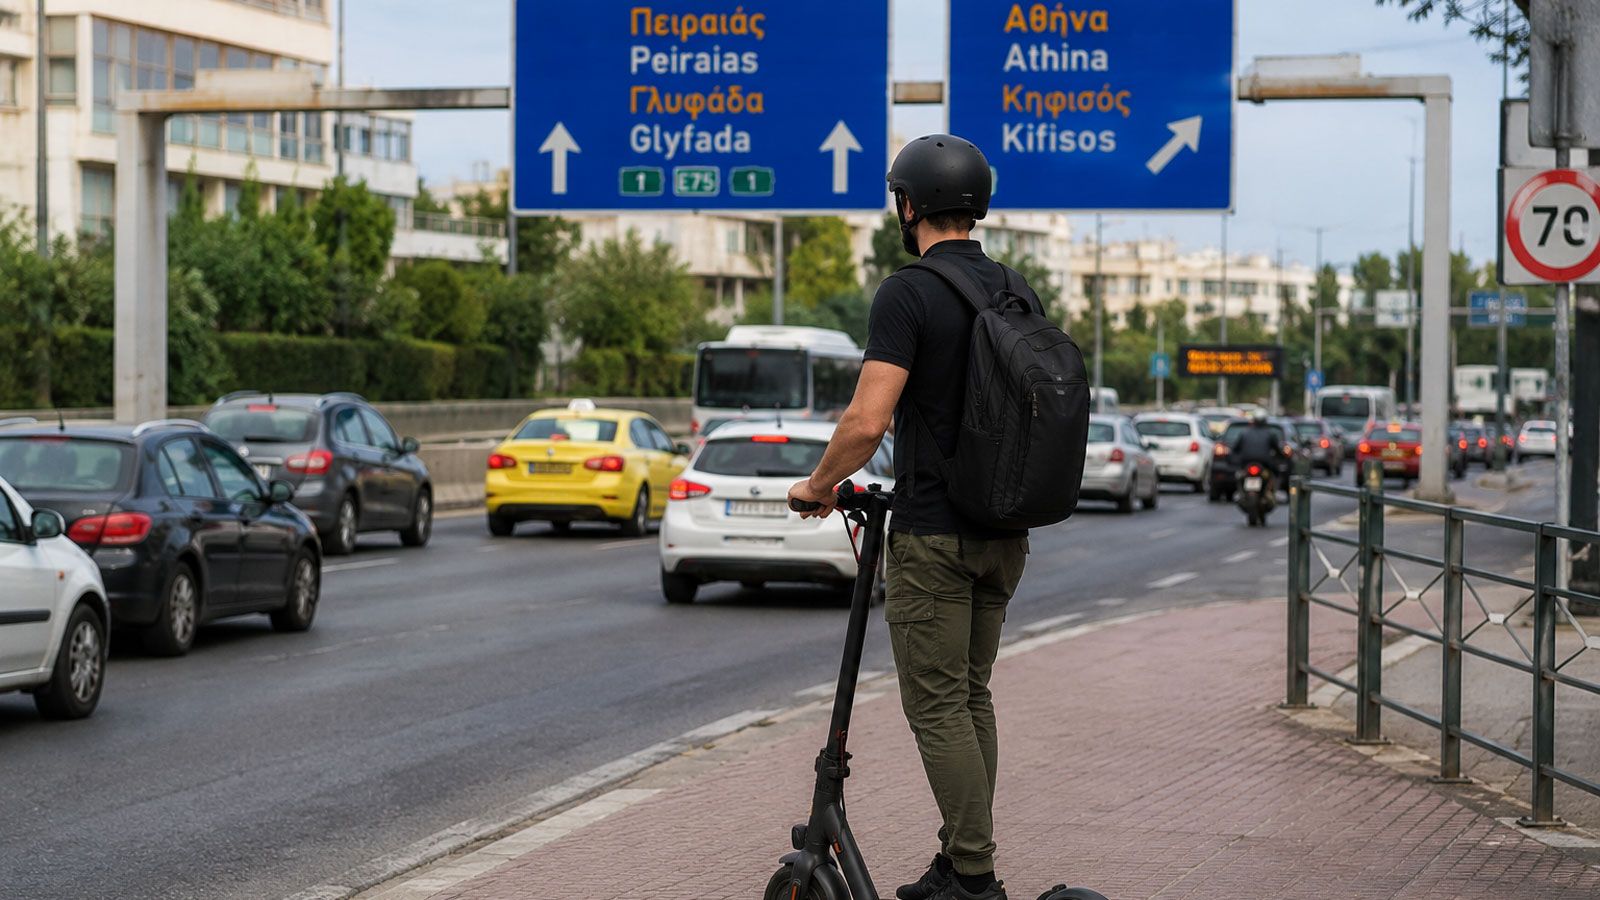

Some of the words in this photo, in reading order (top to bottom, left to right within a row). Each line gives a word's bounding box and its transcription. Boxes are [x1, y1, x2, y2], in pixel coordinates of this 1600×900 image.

[630, 7, 765, 42] Πειραιάς
[1004, 4, 1108, 37] Αθήνα
[630, 46, 758, 74] Peiraias
[1003, 43, 1108, 72] Athina
[630, 86, 764, 120] Γλυφάδα
[1003, 84, 1131, 119] Κηφισός
[630, 125, 751, 160] Glyfada
[1003, 123, 1116, 152] Kifisos
[636, 172, 646, 191] 1
[679, 172, 715, 191] E75
[747, 172, 756, 191] 1
[1532, 206, 1589, 247] 70
